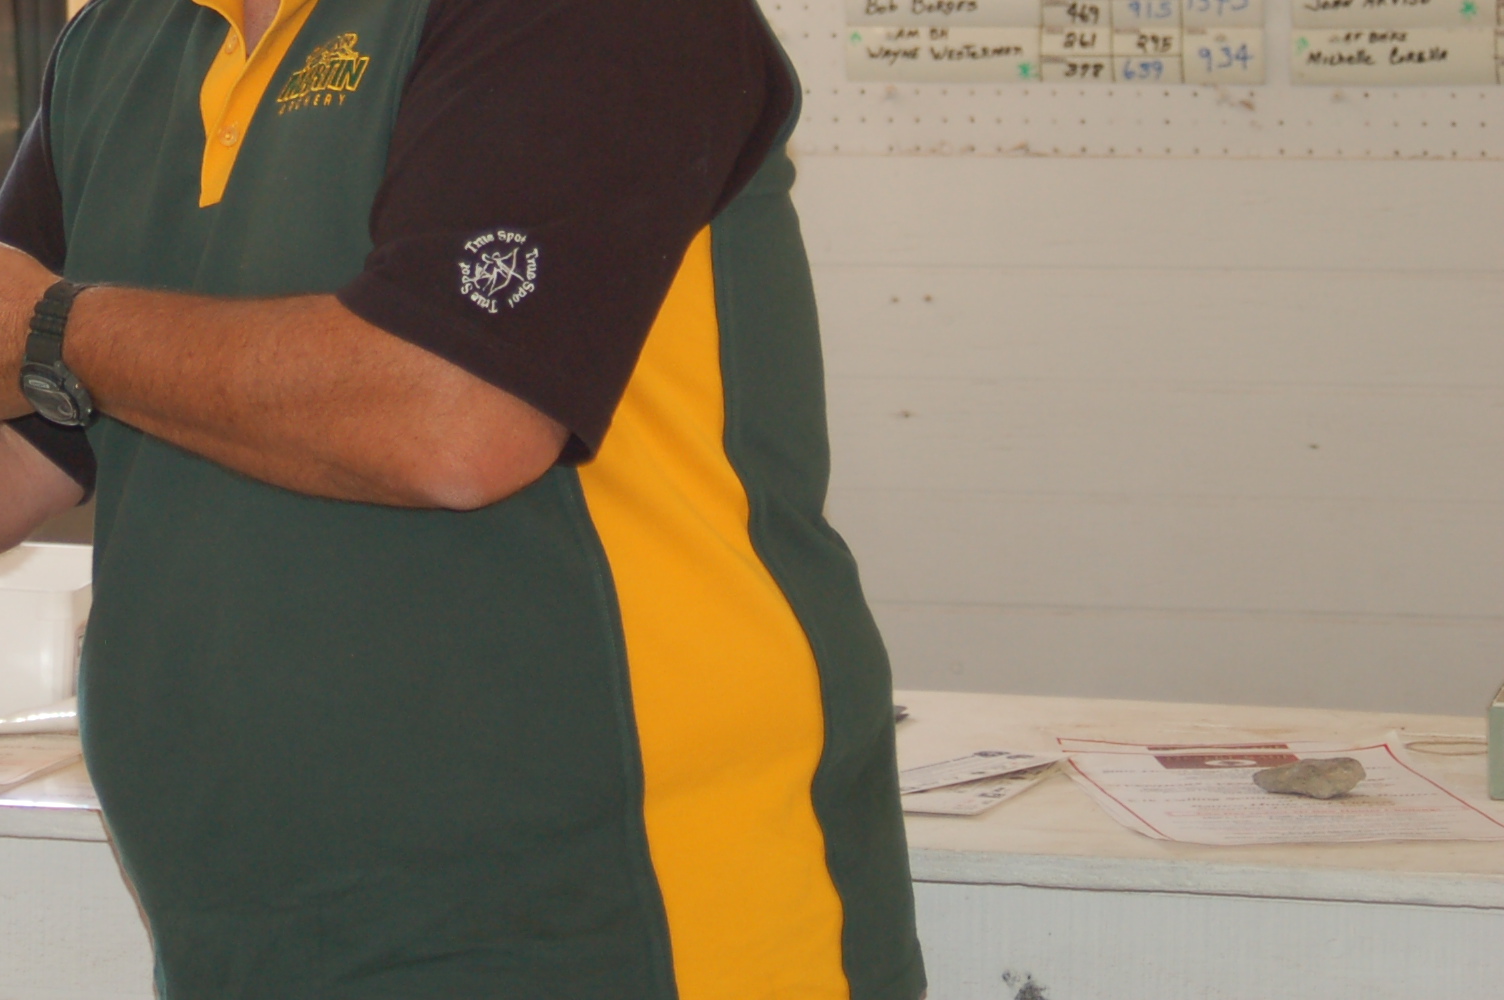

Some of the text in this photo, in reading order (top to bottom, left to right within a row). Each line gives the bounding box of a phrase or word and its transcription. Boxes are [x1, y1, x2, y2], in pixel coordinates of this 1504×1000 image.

[1128, 0, 1173, 20] 915
[1198, 43, 1254, 73] 934
[464, 230, 527, 254] True Spot
[525, 247, 539, 281] True
